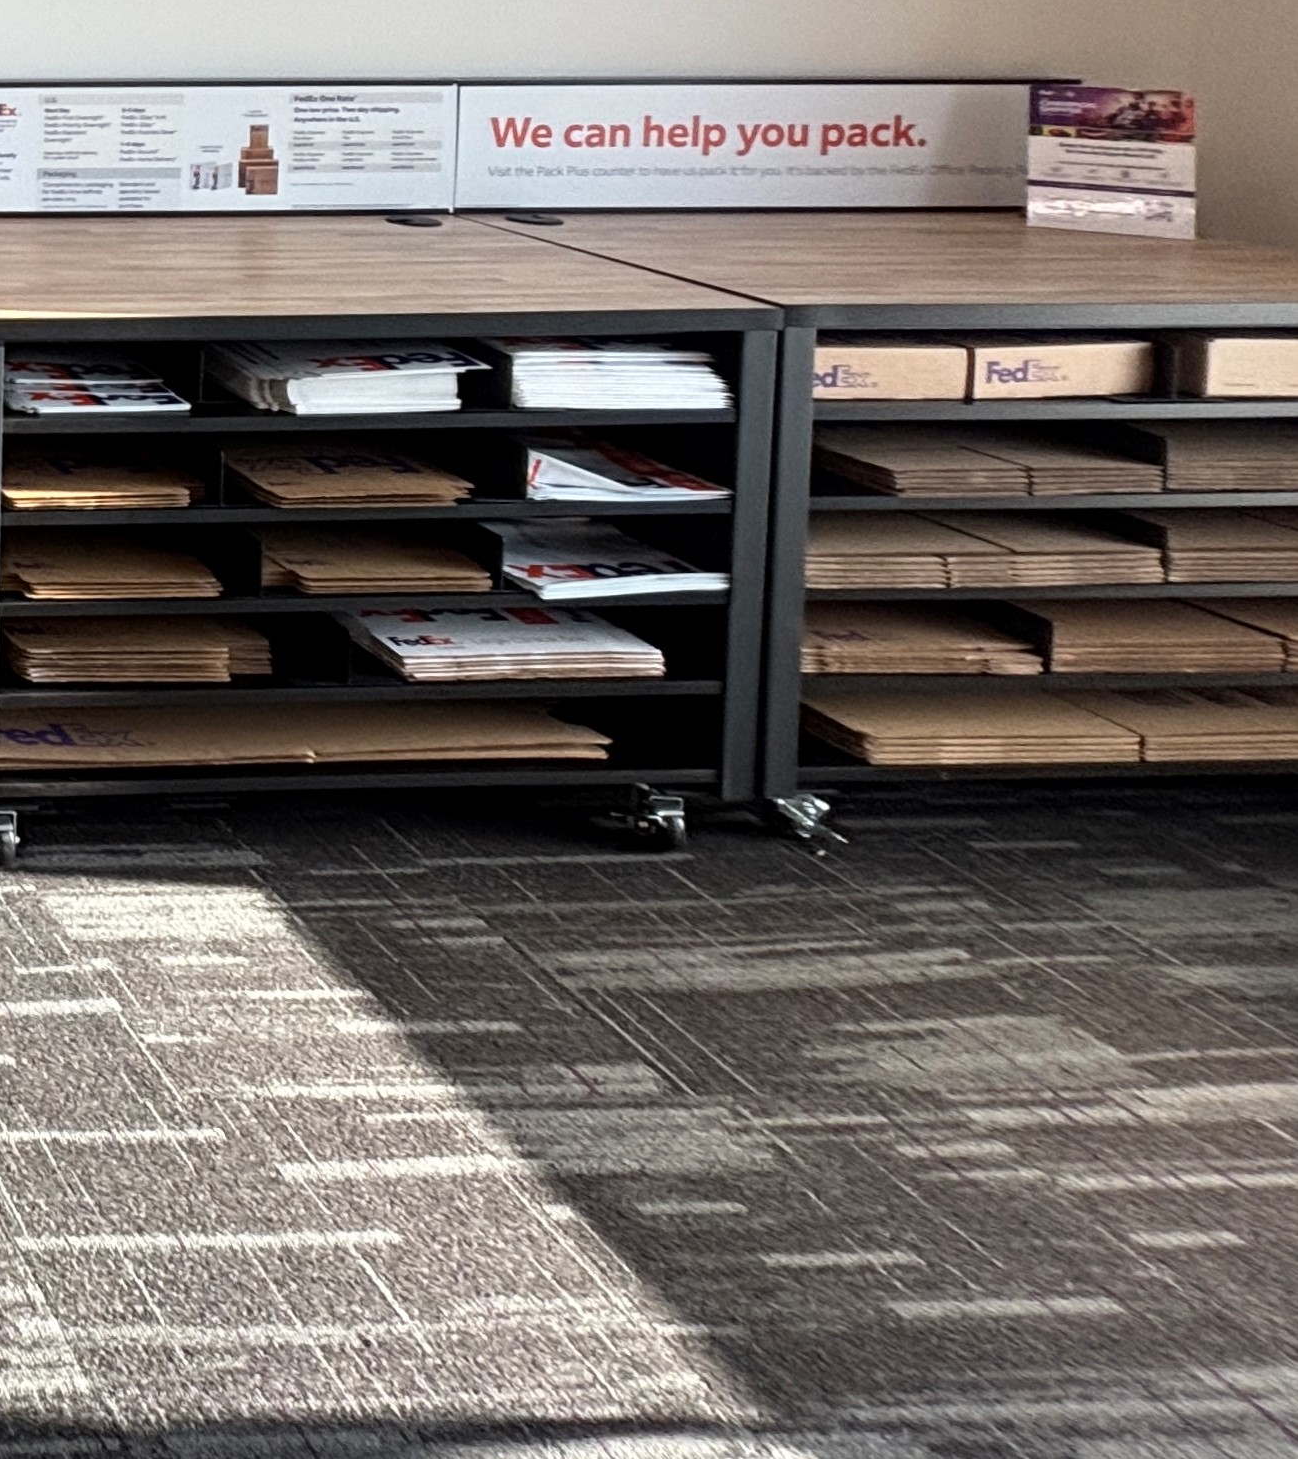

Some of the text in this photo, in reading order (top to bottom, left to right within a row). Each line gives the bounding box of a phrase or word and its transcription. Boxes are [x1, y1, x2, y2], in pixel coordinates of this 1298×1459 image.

[490, 114, 928, 157] We can help you pack.
[488, 165, 512, 177] Visit
[514, 165, 534, 177] the
[536, 165, 564, 177] Pack
[813, 364, 873, 388] edEx
[985, 358, 1062, 384] FedEx
